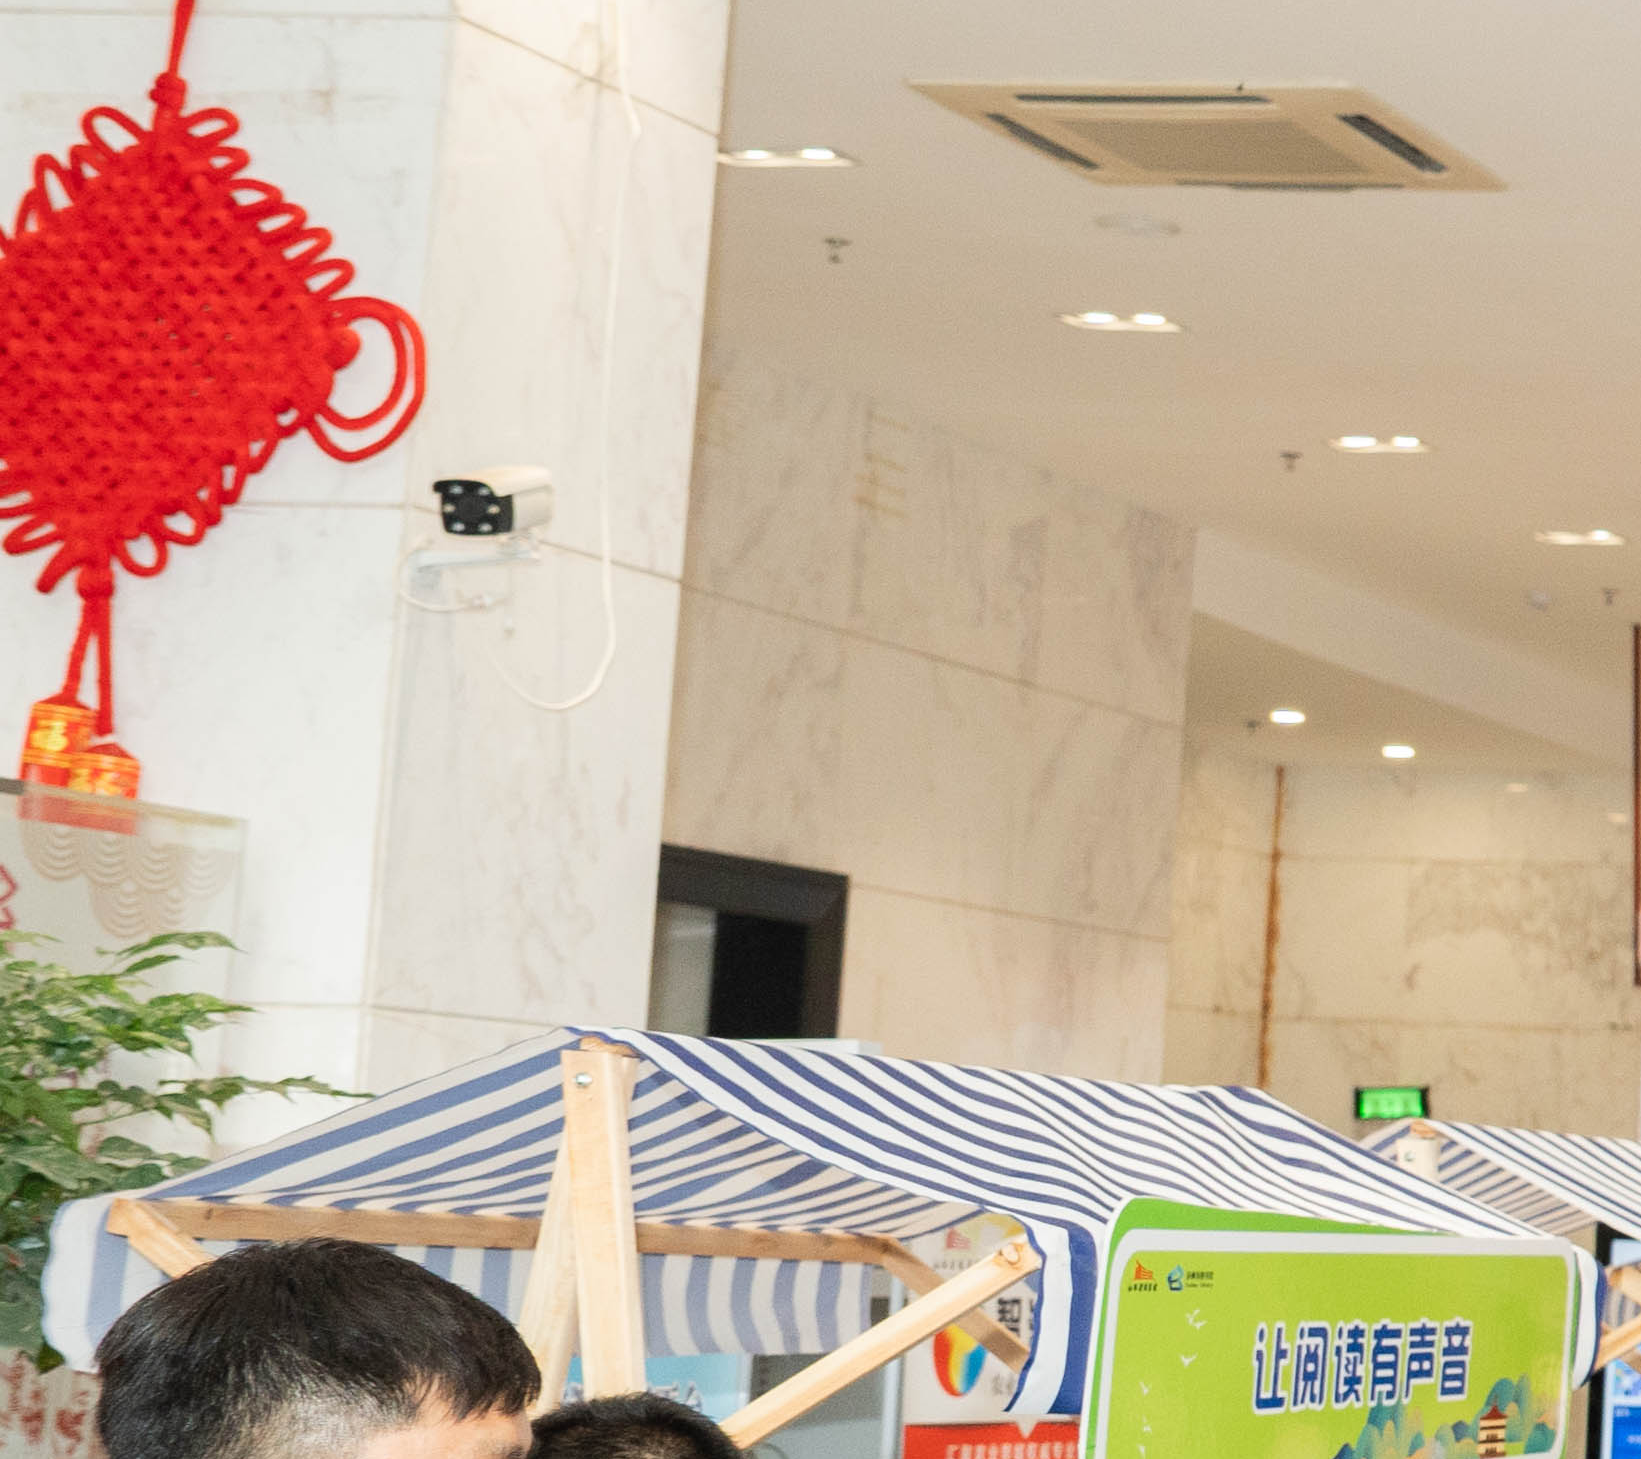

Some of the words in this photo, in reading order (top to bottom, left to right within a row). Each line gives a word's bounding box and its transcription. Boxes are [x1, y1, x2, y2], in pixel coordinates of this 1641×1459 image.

[1254, 1320, 1472, 1410] 让阅读有声音
